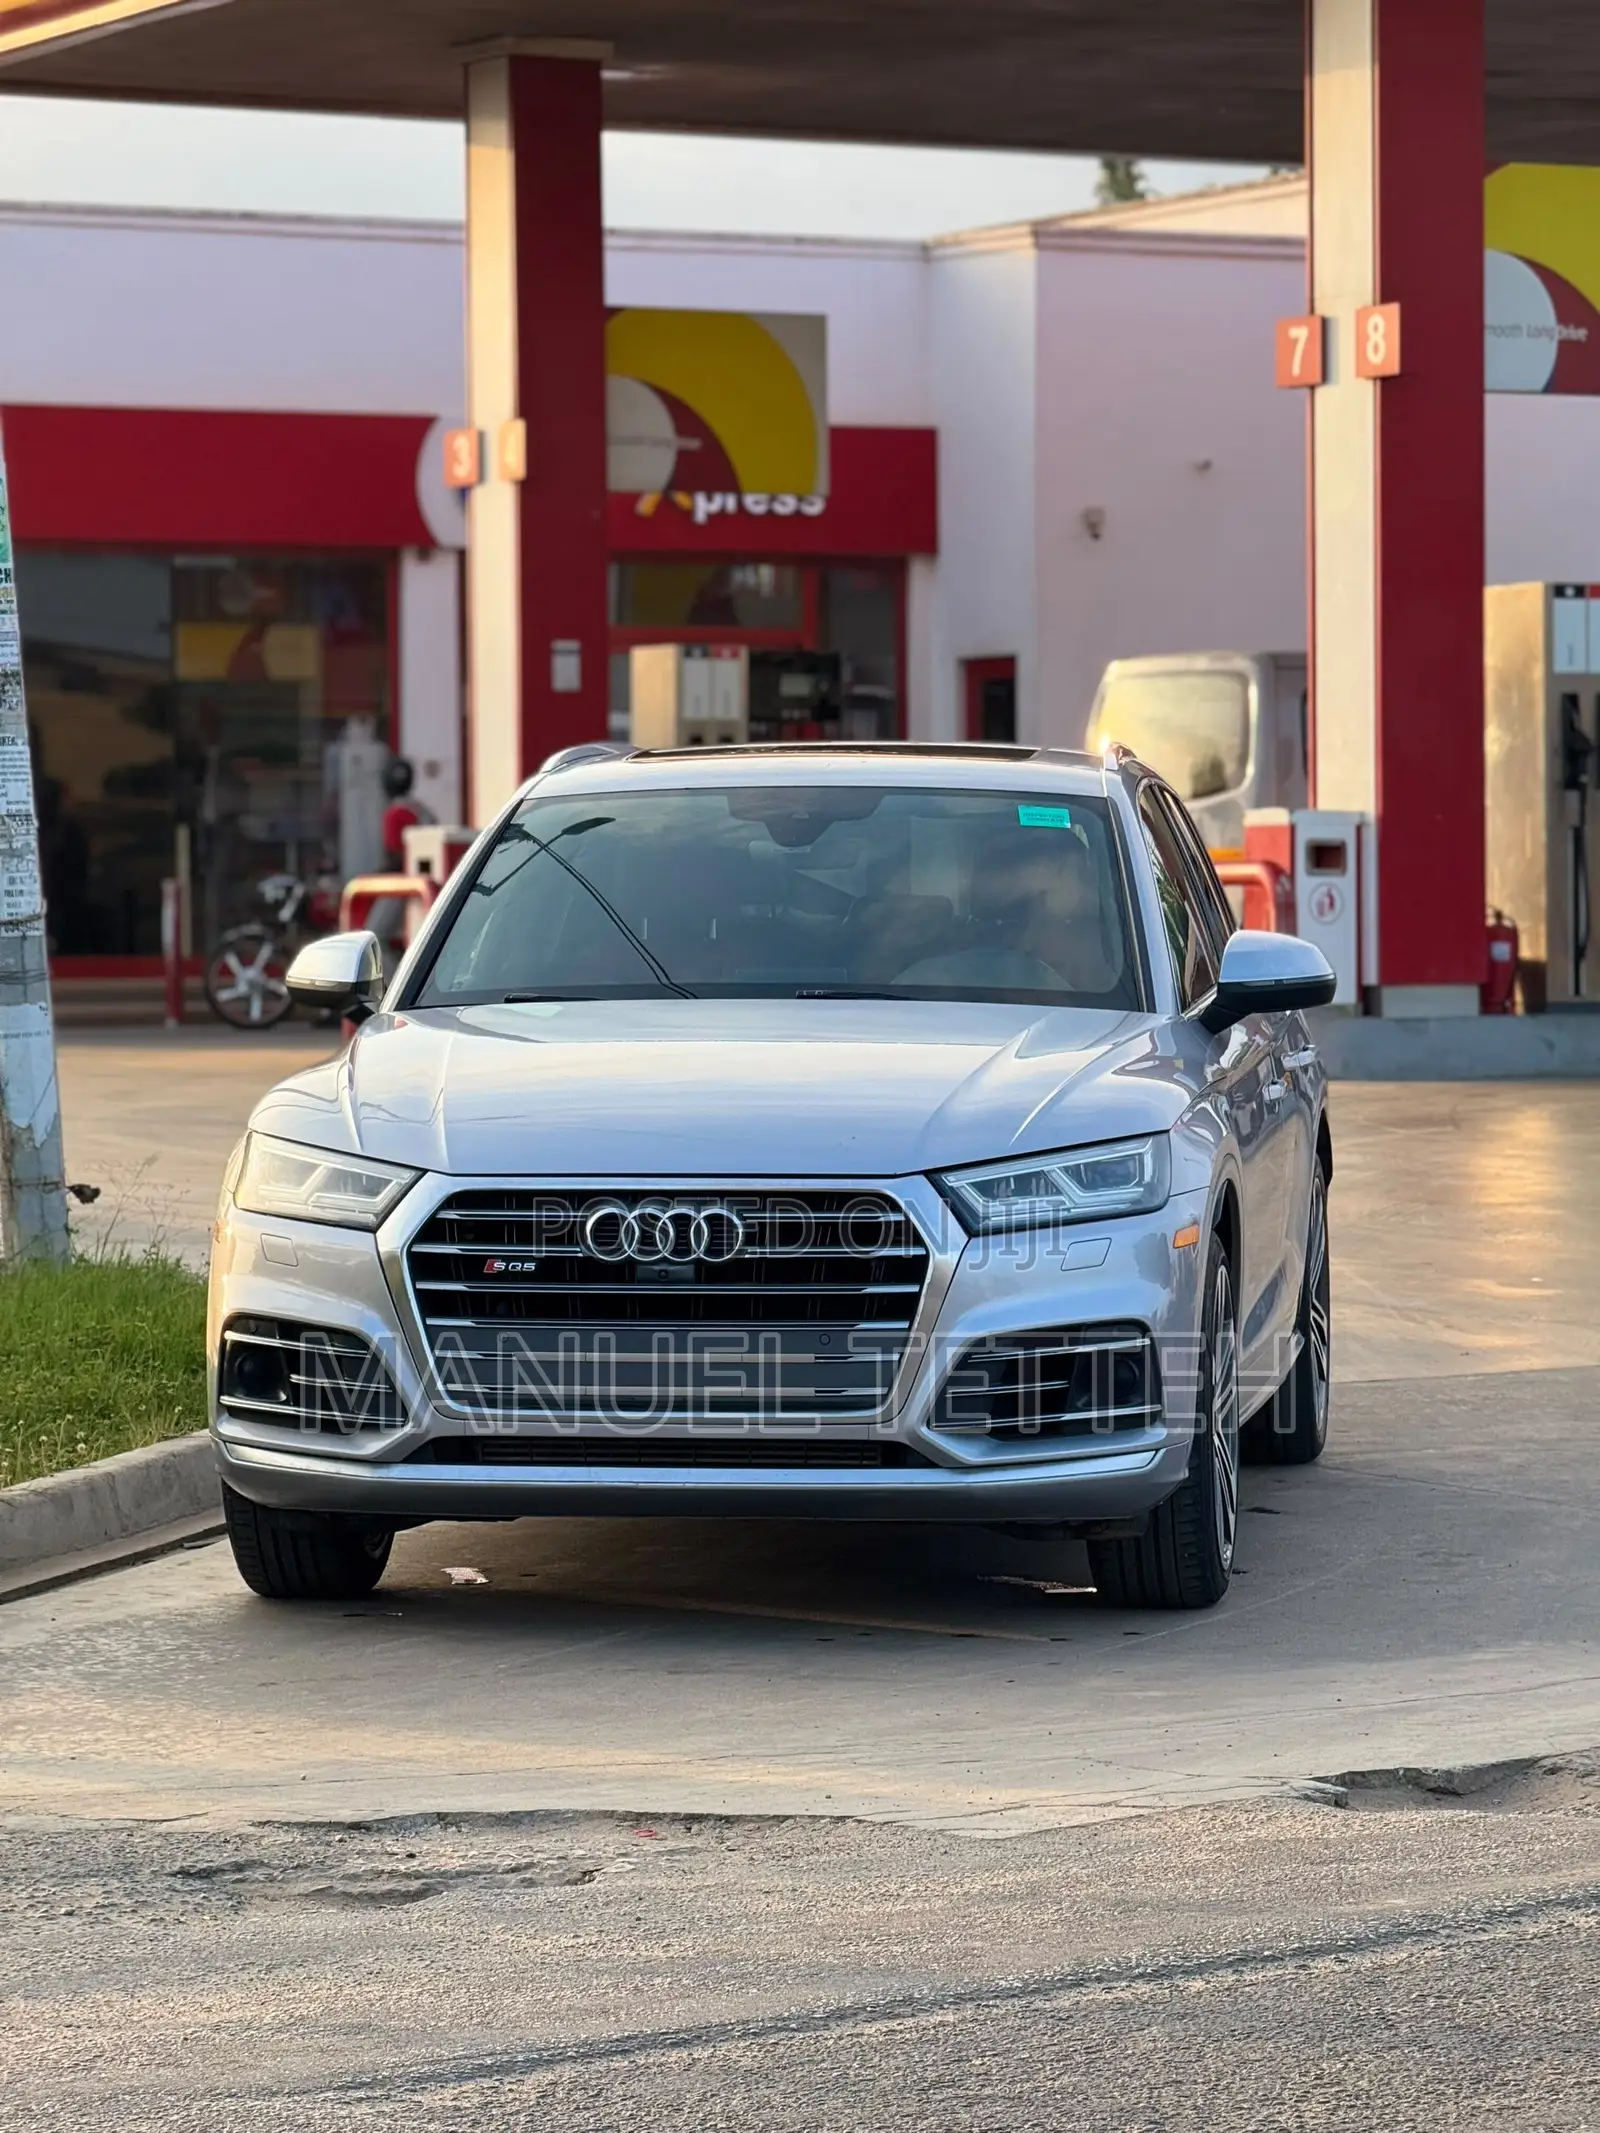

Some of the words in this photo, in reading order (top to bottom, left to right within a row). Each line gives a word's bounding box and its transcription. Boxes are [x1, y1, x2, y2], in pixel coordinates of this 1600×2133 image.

[1288, 325, 1308, 377] 7
[1366, 313, 1385, 365] 8
[1526, 323, 1556, 342] Long
[1557, 324, 1588, 342] Drive
[453, 434, 472, 478] 3
[490, 1261, 536, 1273] SQ5
